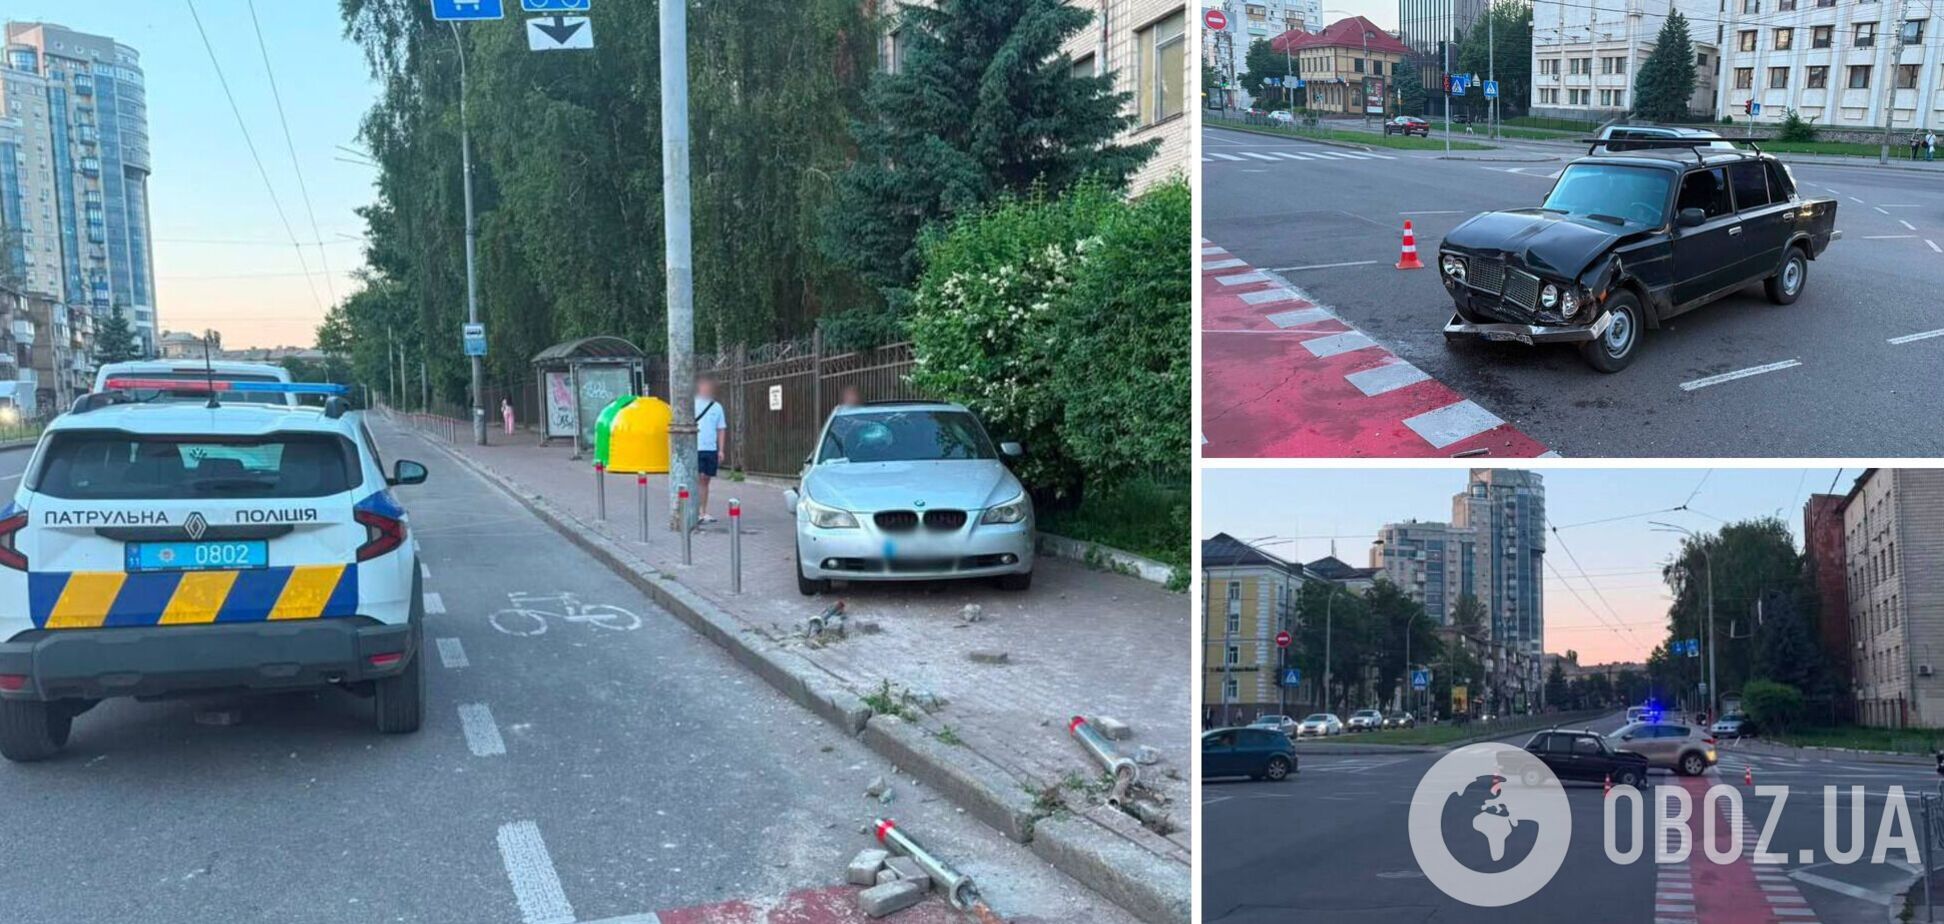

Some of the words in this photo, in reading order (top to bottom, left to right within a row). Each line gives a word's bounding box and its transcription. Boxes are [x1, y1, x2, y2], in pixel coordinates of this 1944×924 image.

[44, 510, 169, 525] ПАТРУЛЬНА
[235, 508, 317, 523] ПОЛІЦІЯ
[194, 544, 249, 564] 0802
